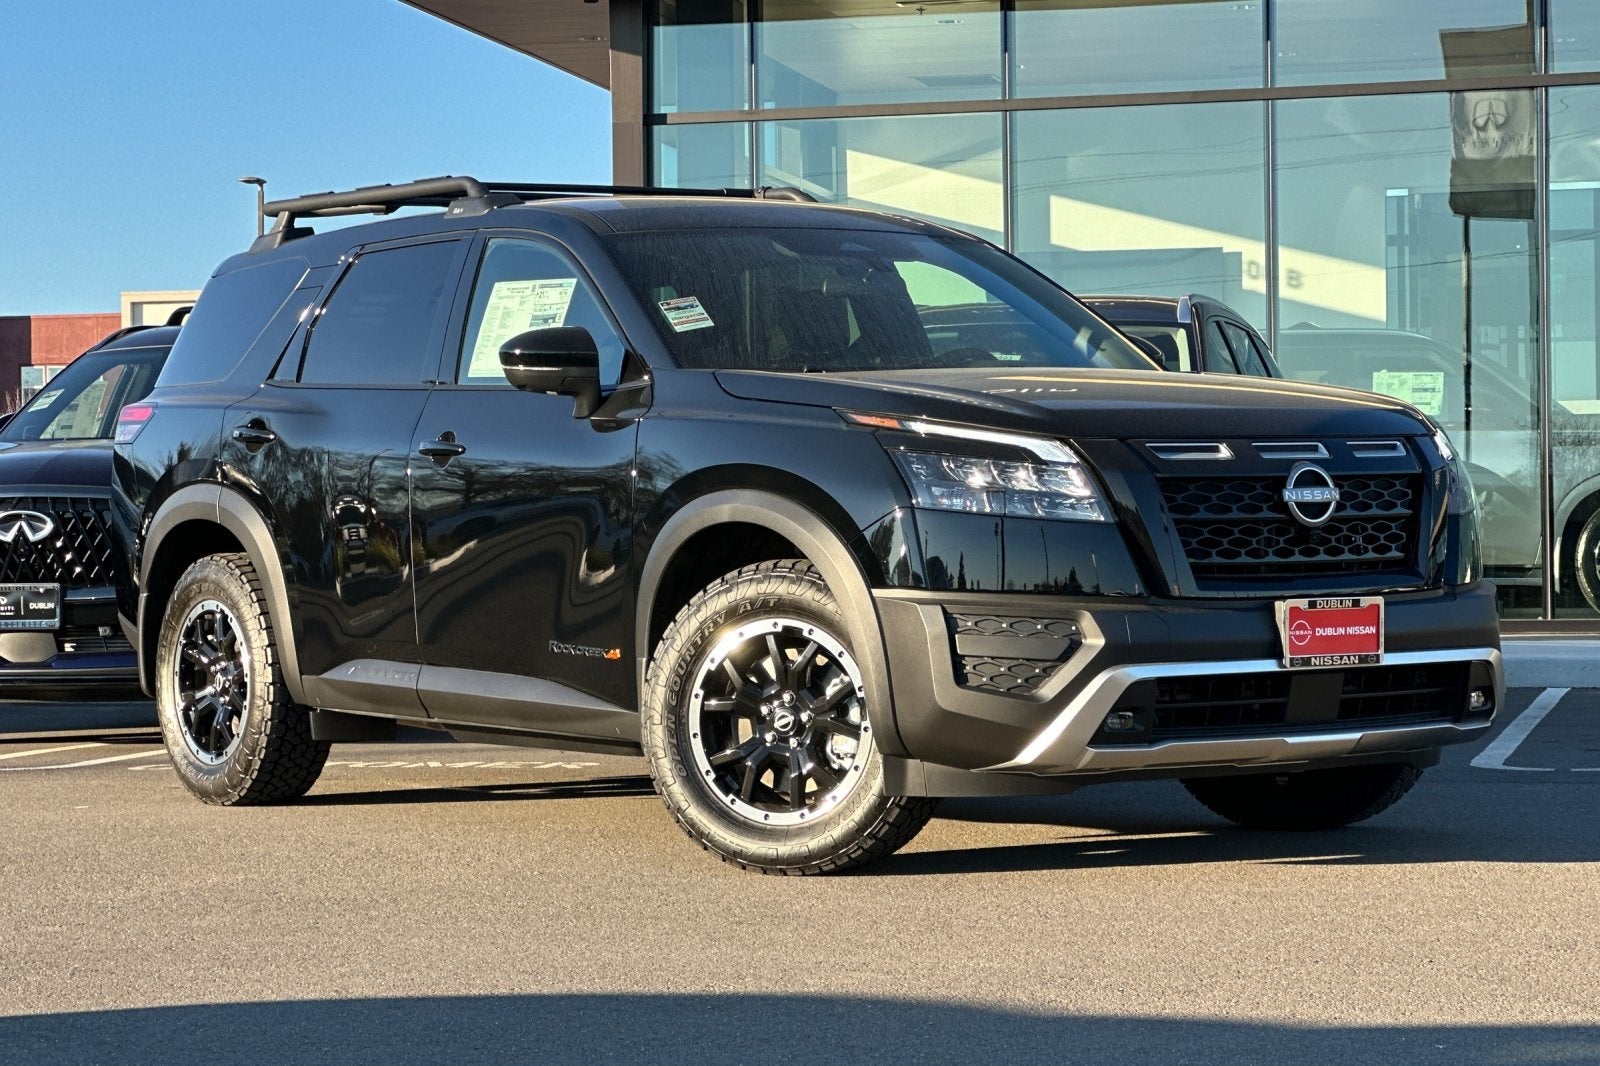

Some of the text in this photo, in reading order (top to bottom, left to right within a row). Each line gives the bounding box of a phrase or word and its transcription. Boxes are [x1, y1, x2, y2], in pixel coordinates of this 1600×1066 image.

[1285, 490, 1339, 500] NISSAN
[29, 602, 55, 610] DUBLIN
[1316, 599, 1353, 609] DUBLIN
[1315, 626, 1376, 637] DUBLIN NISSAN
[1311, 655, 1359, 666] NISSAN
[667, 596, 779, 777] OPEN COUNTRY A/T
